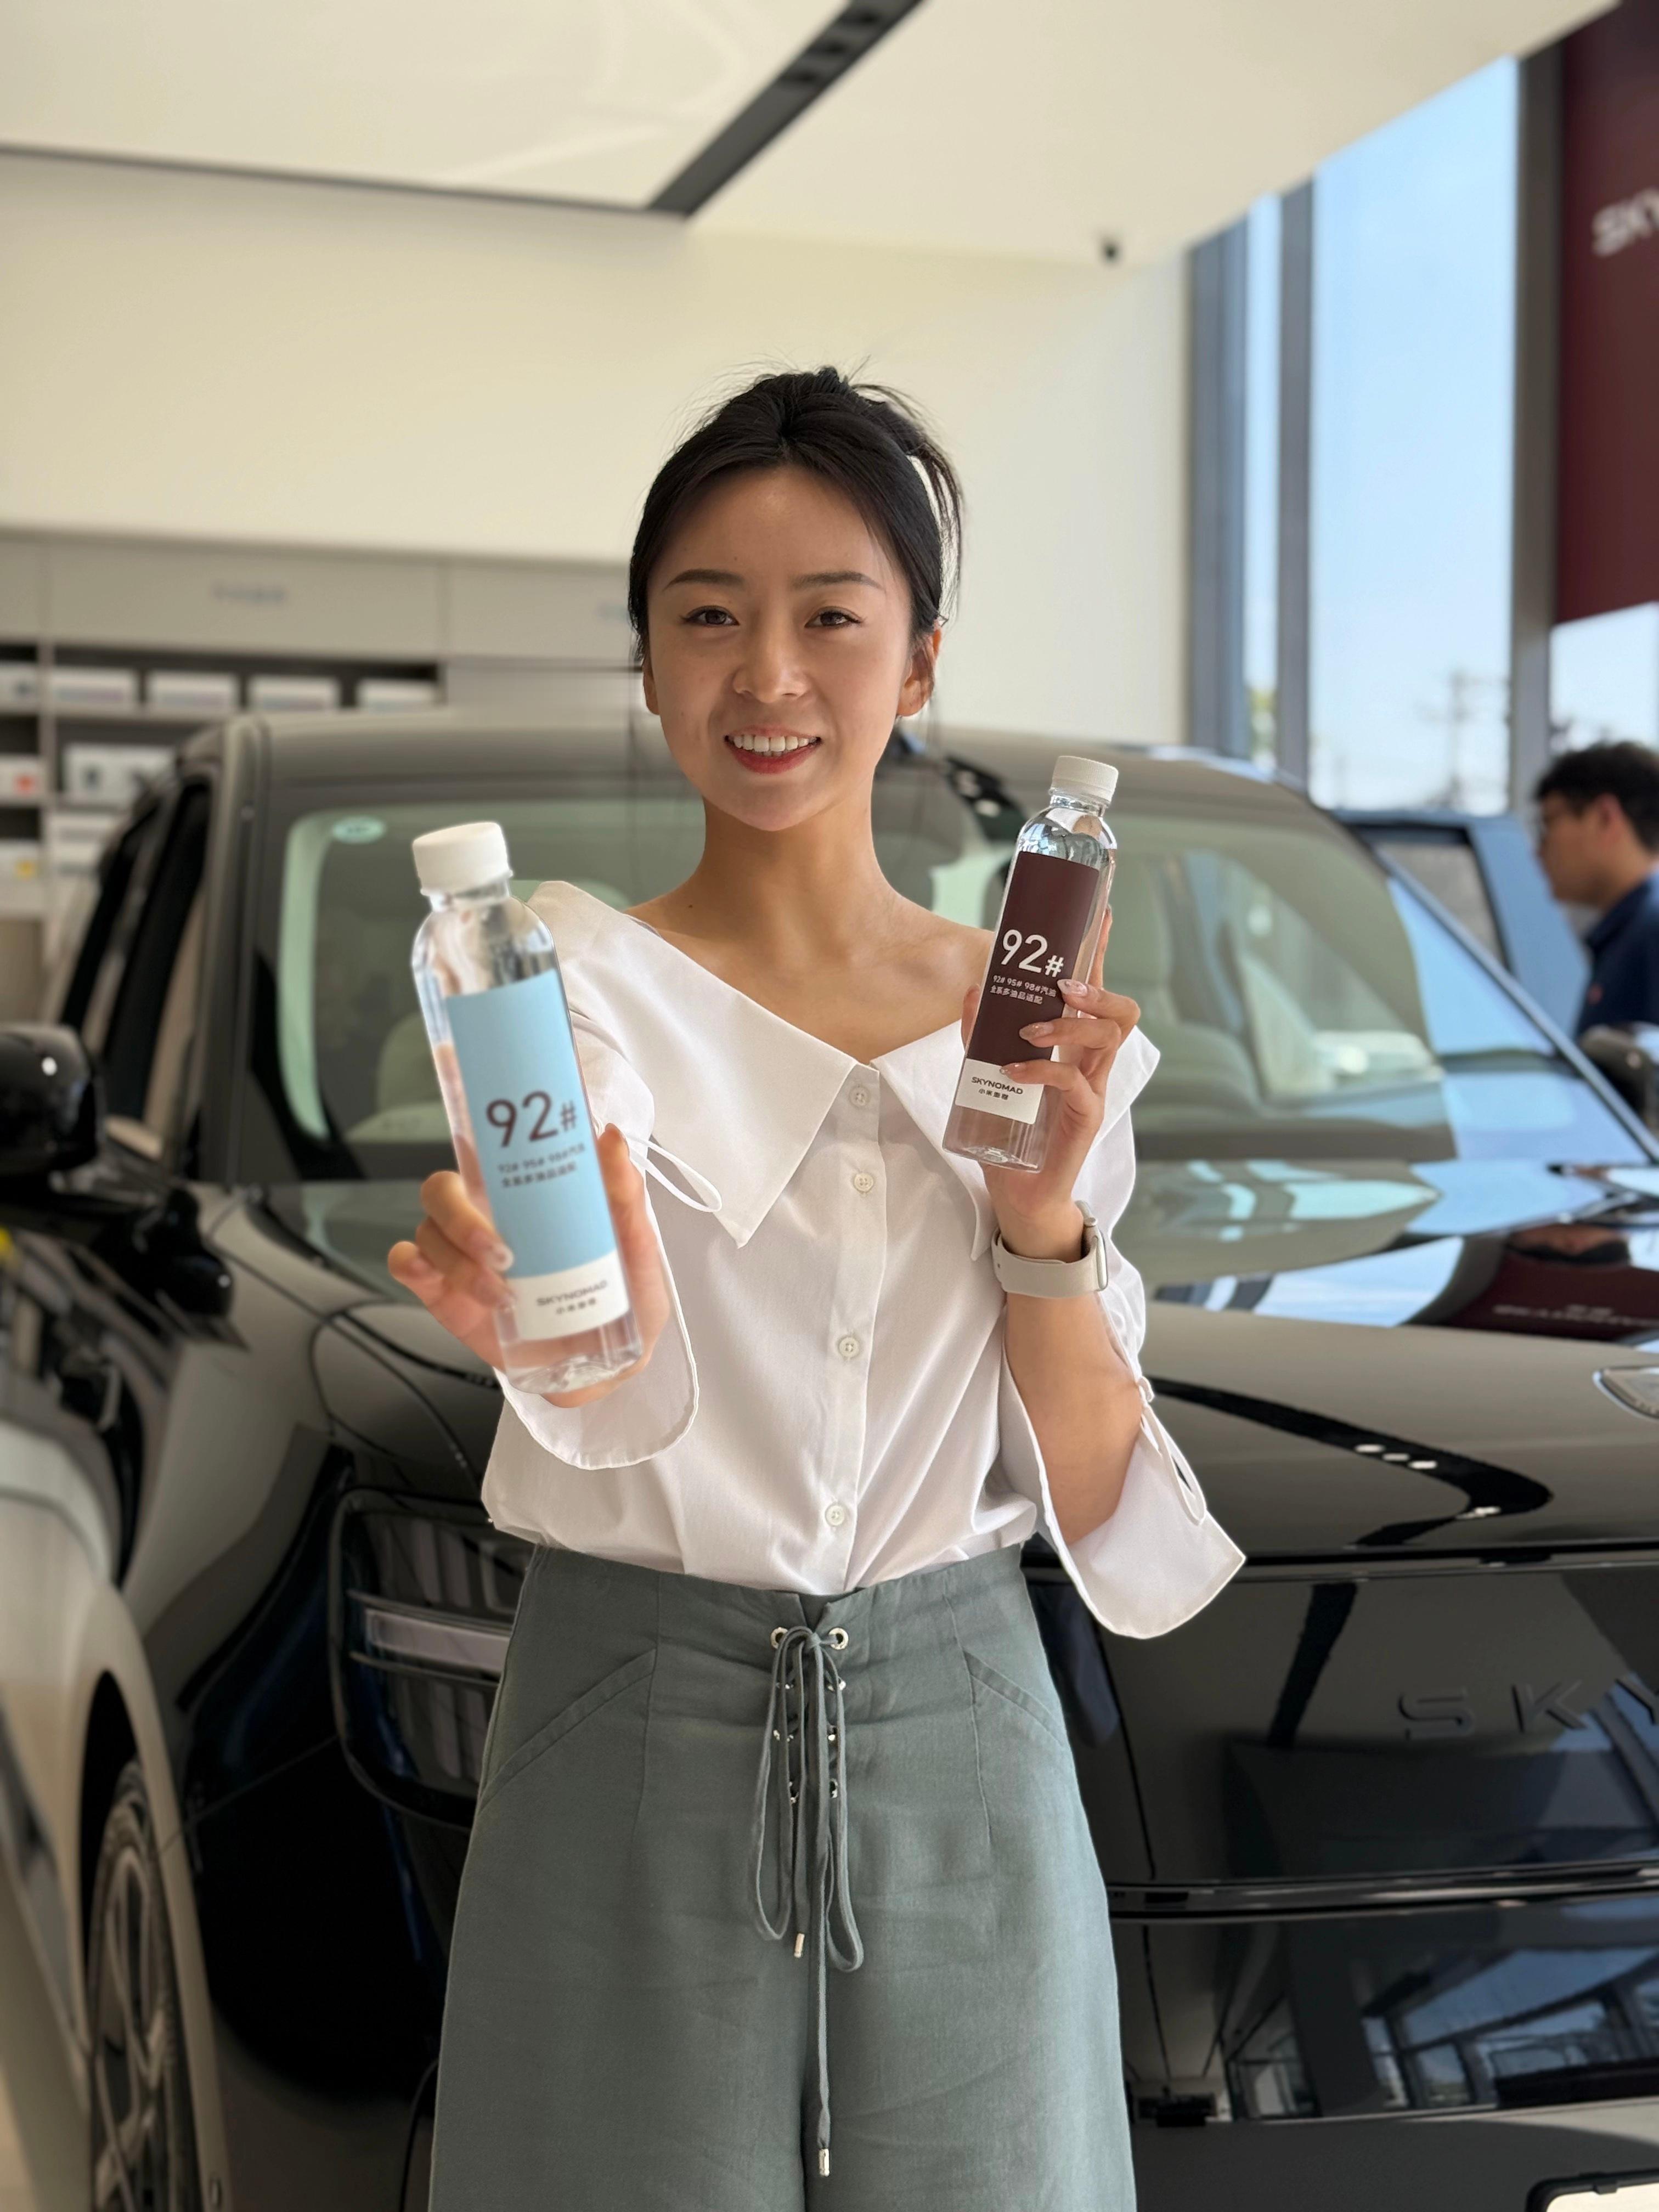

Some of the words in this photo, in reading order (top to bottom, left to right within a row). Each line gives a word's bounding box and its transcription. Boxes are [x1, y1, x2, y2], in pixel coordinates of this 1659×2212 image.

[1001, 929, 1064, 977] 92#
[993, 975, 1006, 984] 92#
[1007, 978, 1023, 987] 95#
[972, 1077, 1023, 1094] SKYNOMAD
[486, 1090, 577, 1148] 92#
